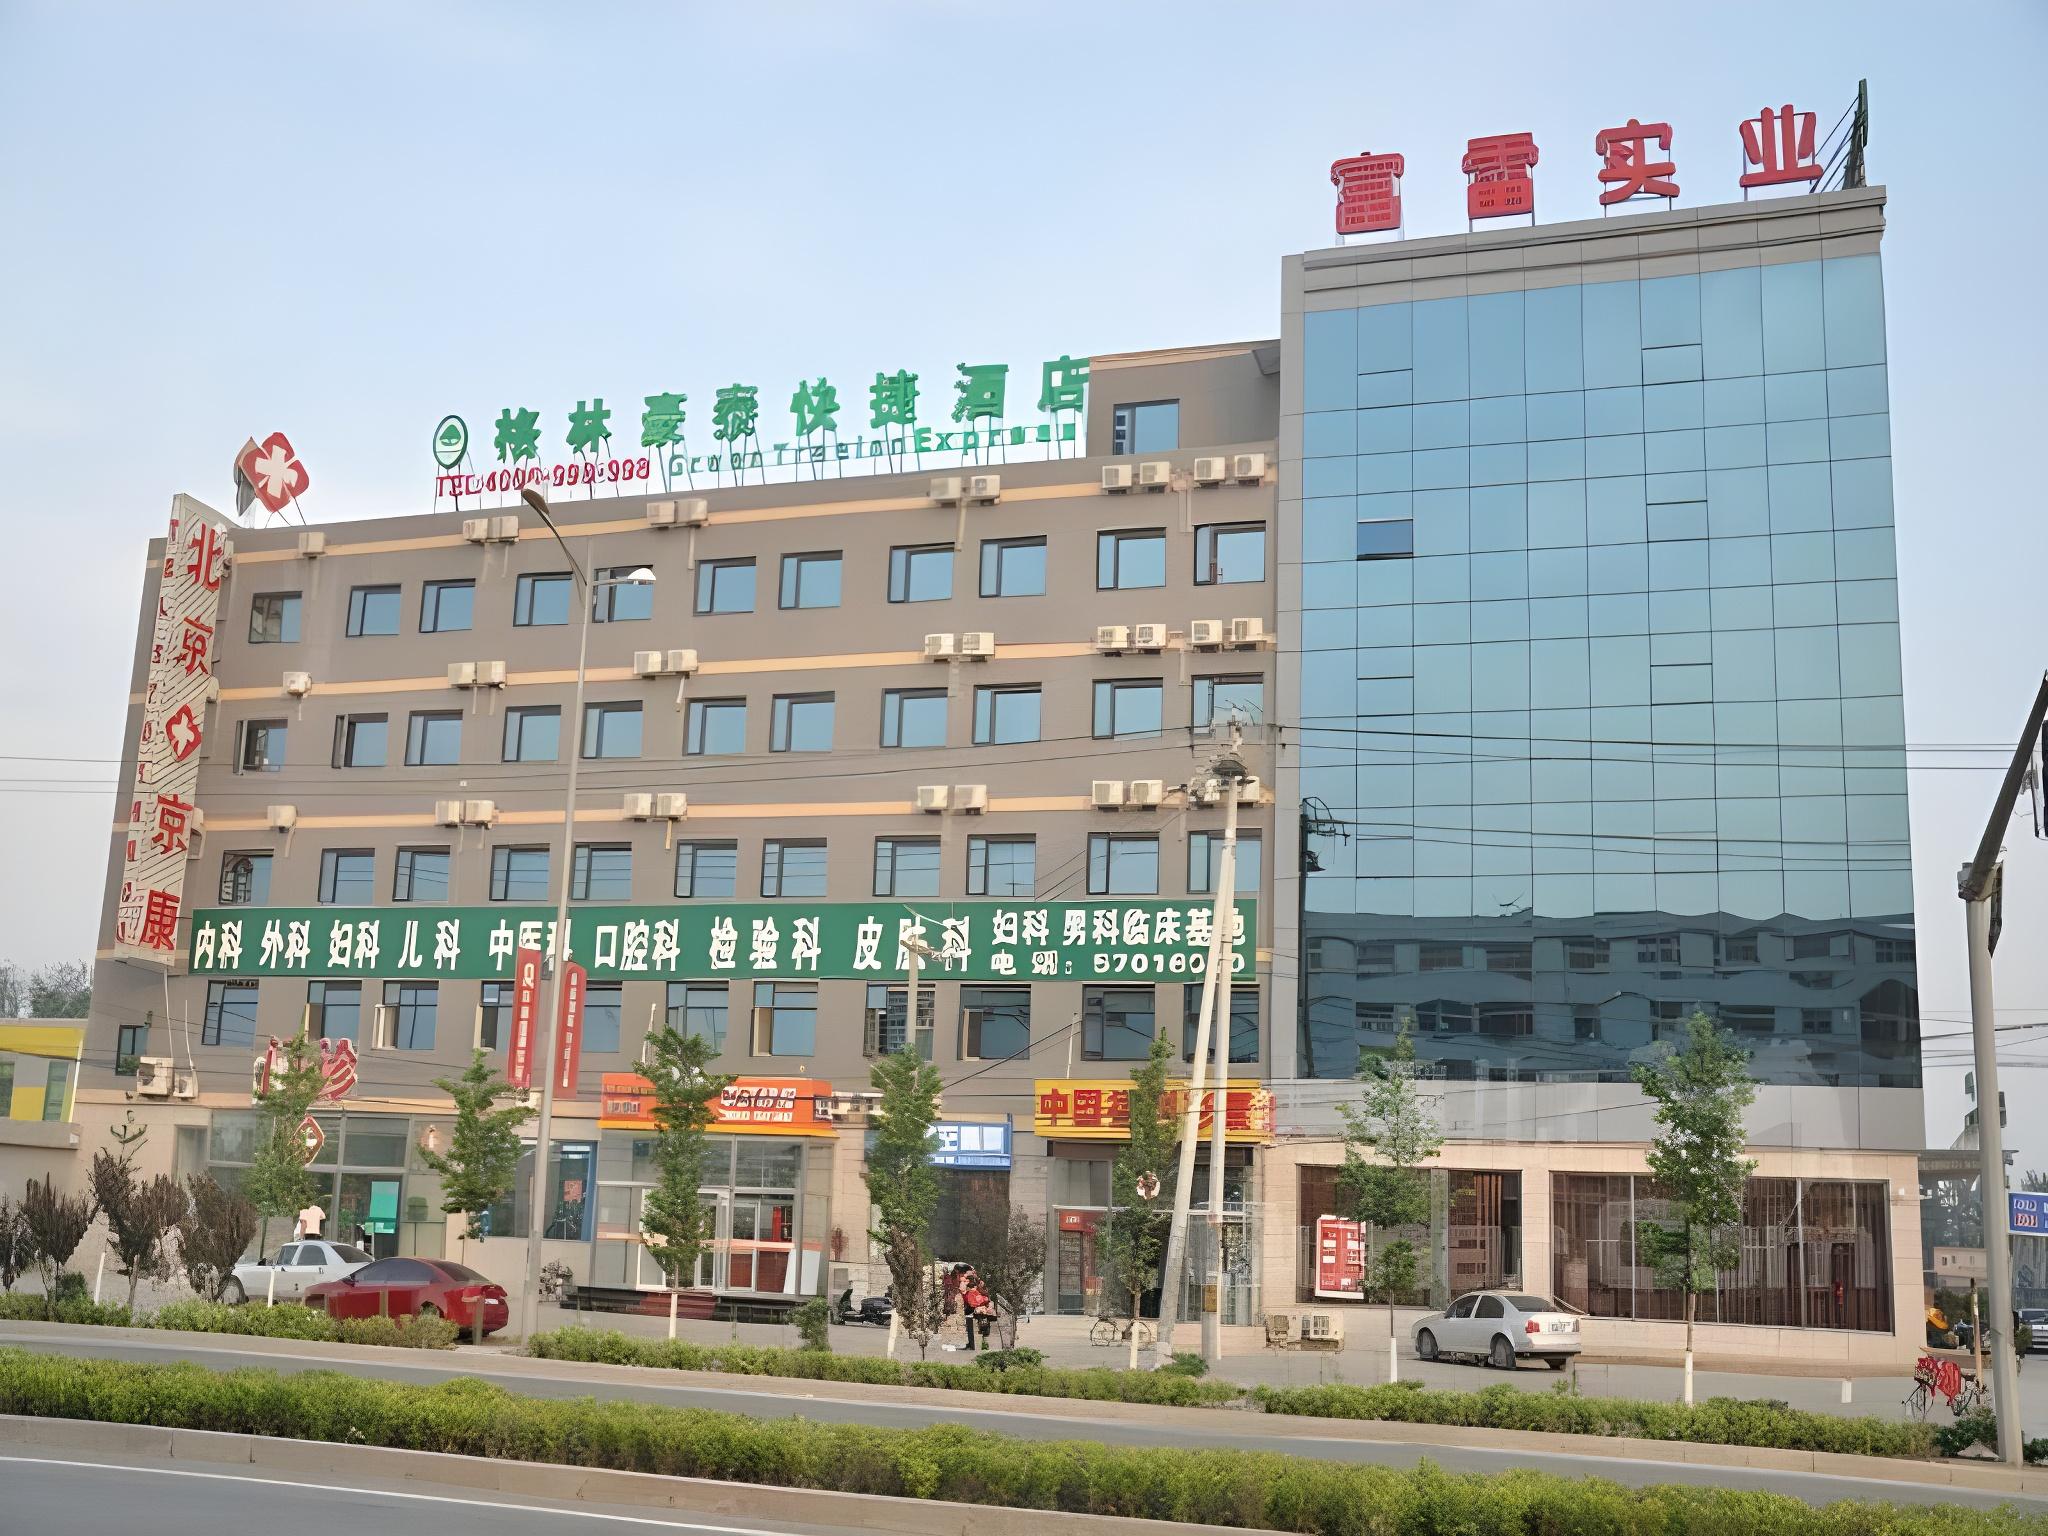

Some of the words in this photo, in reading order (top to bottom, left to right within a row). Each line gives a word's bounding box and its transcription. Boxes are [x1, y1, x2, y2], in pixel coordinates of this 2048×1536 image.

[494, 355, 1090, 464] 格林豪泰快捷酒店
[193, 918, 243, 969] 内科
[259, 918, 311, 969] 外科
[327, 918, 381, 969] 妇科
[397, 917, 461, 970] 儿科
[593, 917, 681, 972] 口腔科
[710, 915, 821, 971] 检验科
[852, 915, 972, 972] 皮肤科
[992, 909, 1050, 946] 妇科
